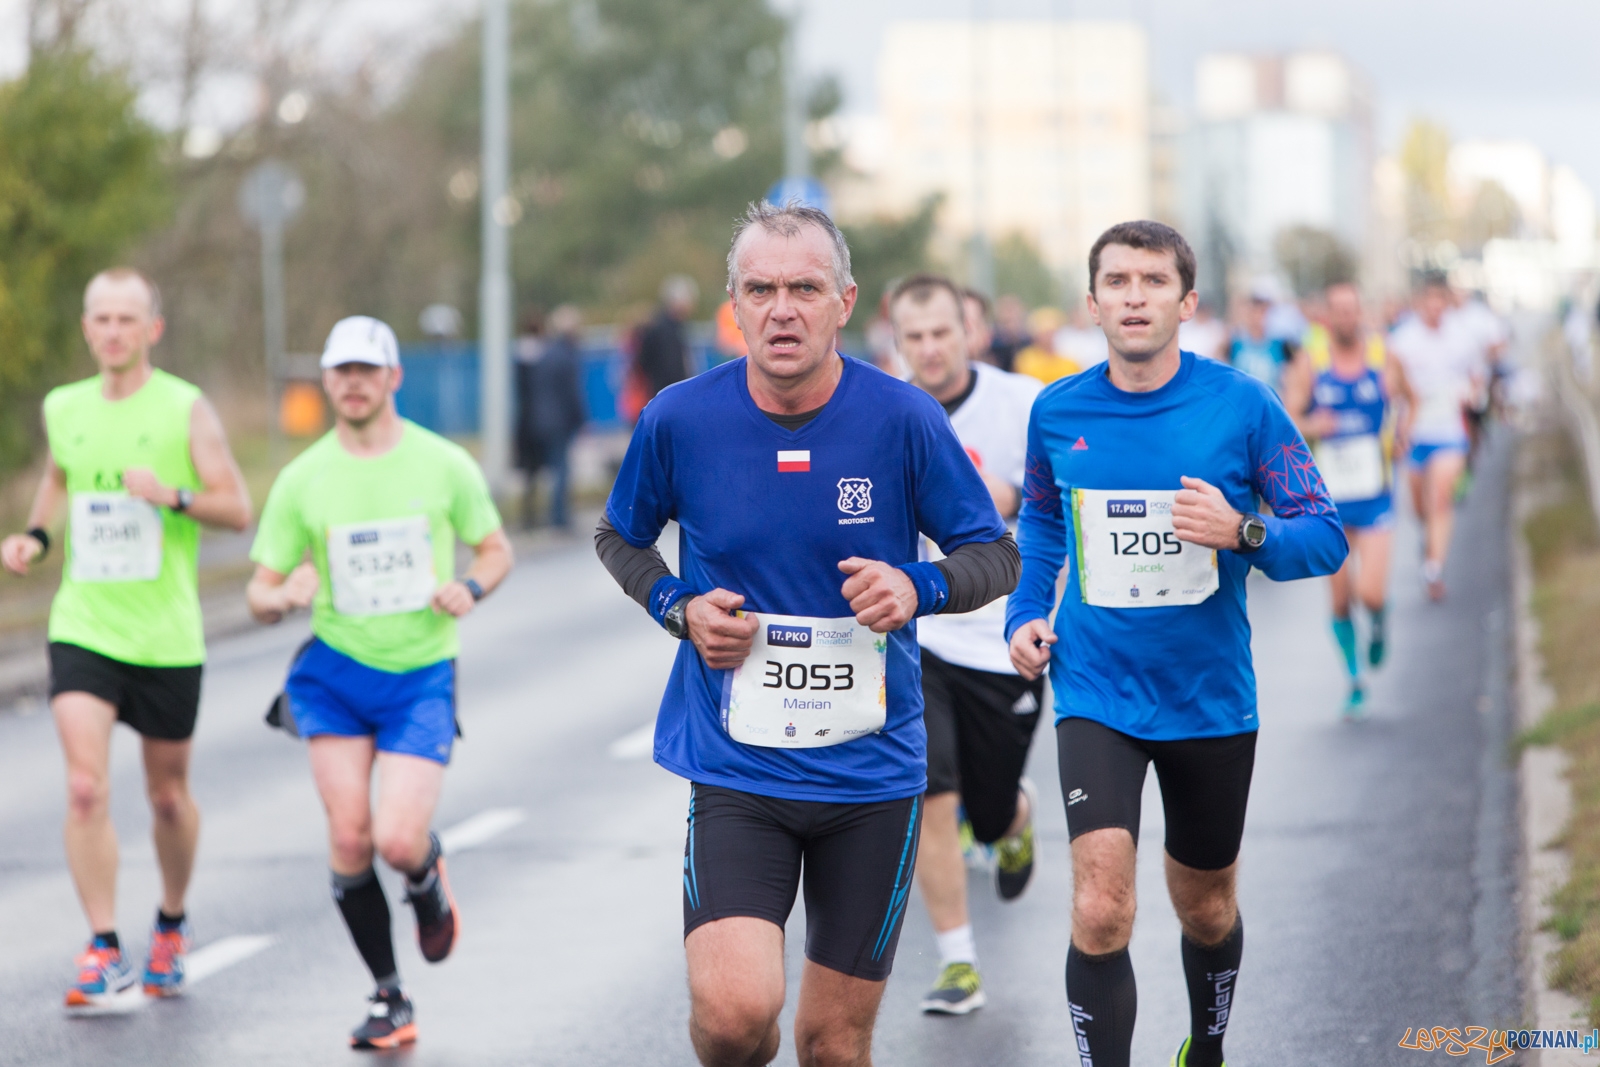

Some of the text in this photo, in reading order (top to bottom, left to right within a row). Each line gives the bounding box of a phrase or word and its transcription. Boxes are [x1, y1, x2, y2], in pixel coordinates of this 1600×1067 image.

[838, 516, 875, 525] KROTOSZYN
[1109, 532, 1182, 555] 1205
[1130, 563, 1165, 573] Jacek
[771, 630, 809, 642] 17.PKO
[816, 636, 853, 645] maraton
[763, 660, 854, 690] 3053
[783, 698, 832, 710] Marian
[814, 728, 831, 737] 4F
